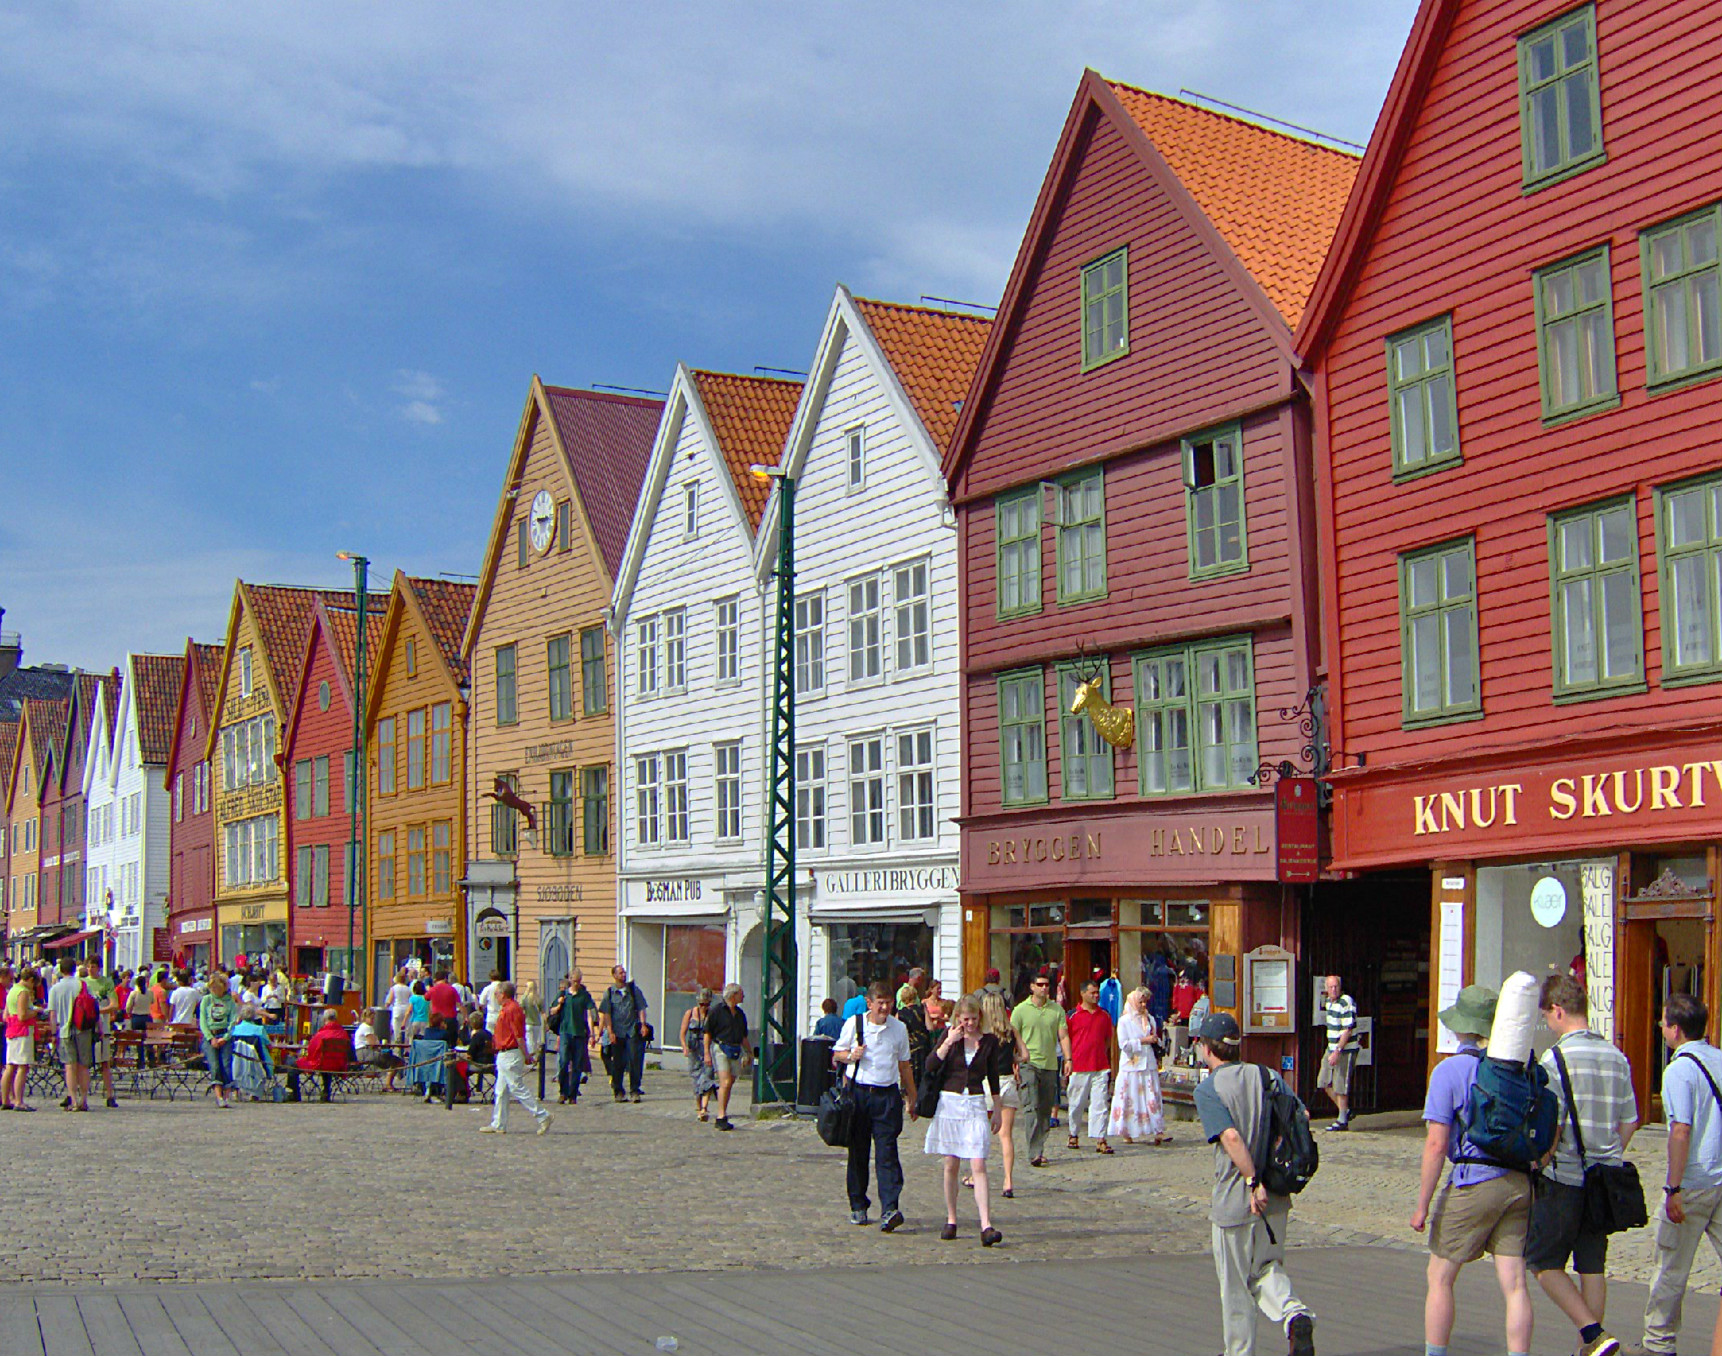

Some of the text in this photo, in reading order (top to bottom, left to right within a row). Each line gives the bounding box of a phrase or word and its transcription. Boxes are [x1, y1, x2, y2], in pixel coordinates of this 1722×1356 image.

[1413, 784, 1523, 836] KNUT
[988, 826, 1270, 865] BRYGGEN HANDEL
[684, 879, 701, 901] PUB
[826, 867, 959, 893] GALLERI BRYGGEN
[1581, 866, 1611, 889] SALG
[1586, 951, 1612, 978] ALE
[1588, 985, 1612, 1012] ALG
[1589, 1017, 1612, 1041] ALE
